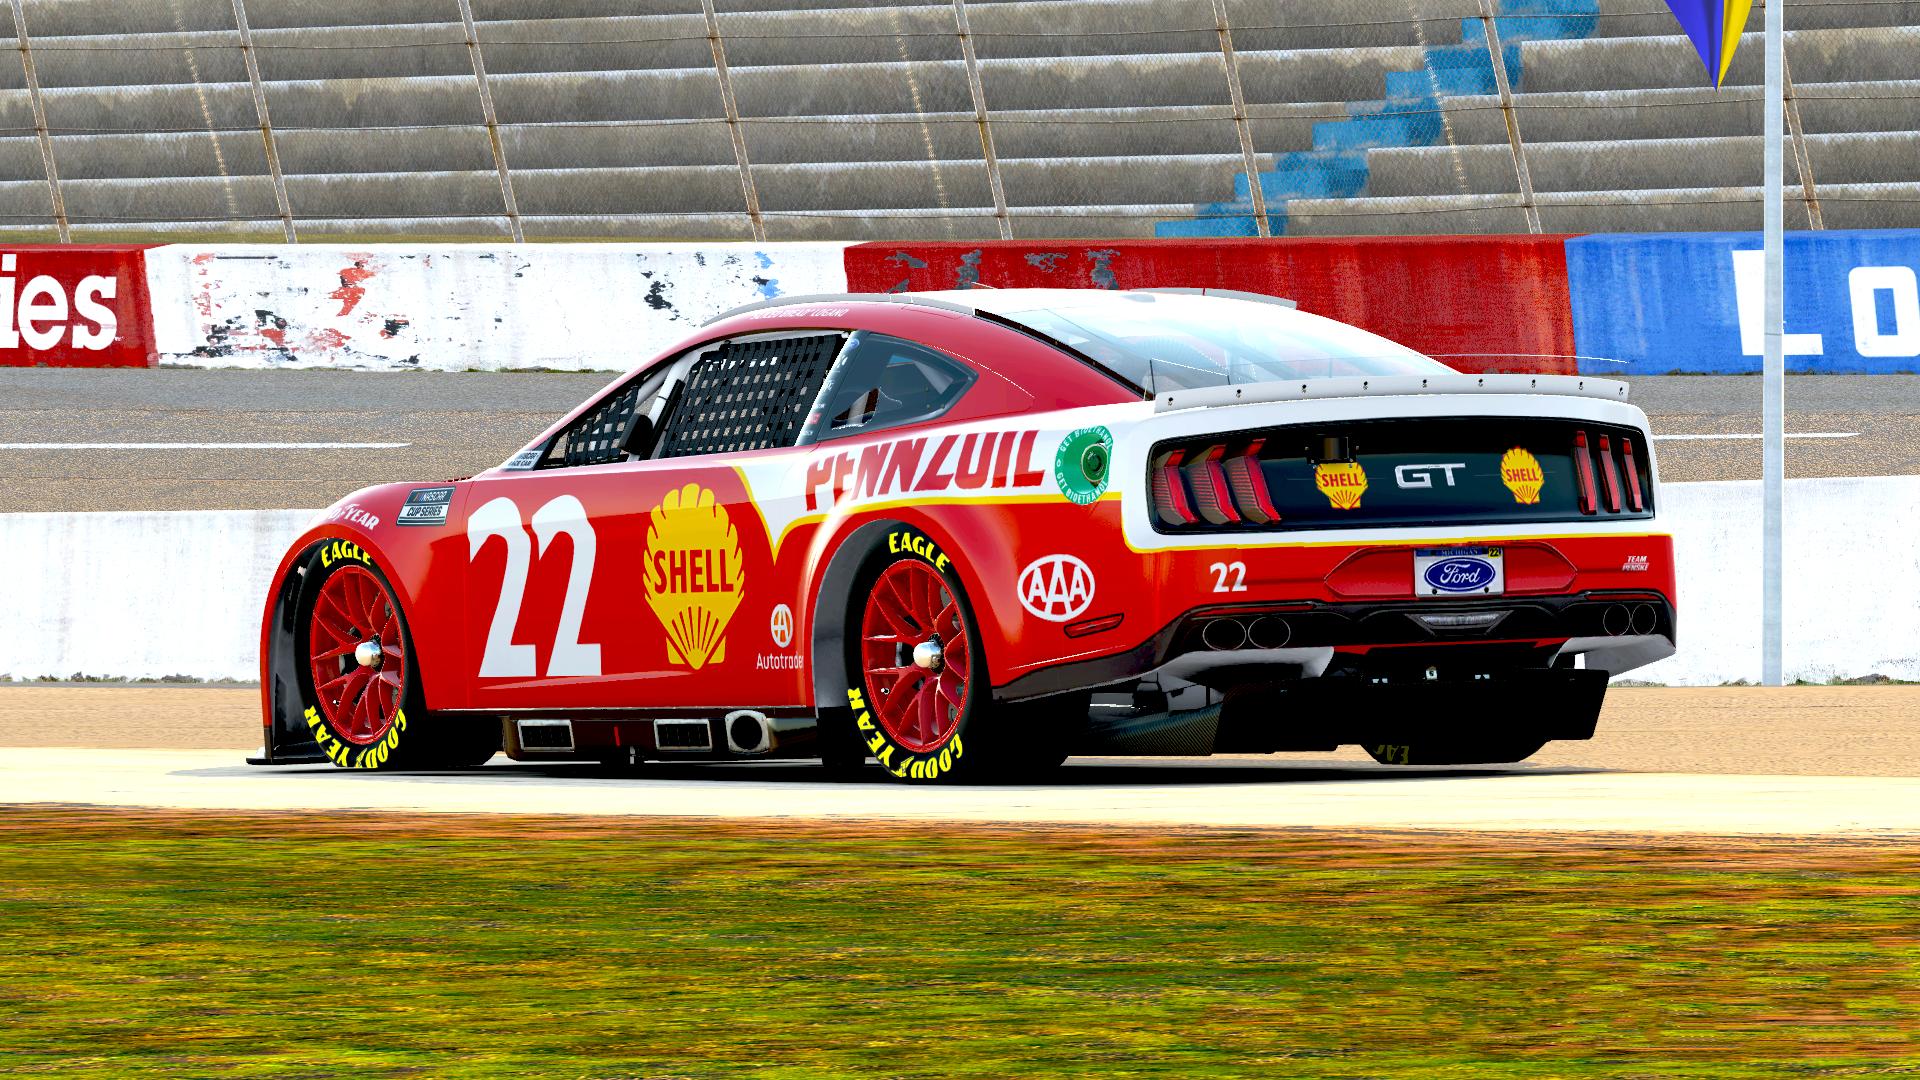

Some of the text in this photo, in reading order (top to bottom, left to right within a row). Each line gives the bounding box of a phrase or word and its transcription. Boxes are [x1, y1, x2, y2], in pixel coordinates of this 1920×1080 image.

[1059, 436, 1073, 452] GET
[1320, 470, 1364, 490] SHELL
[1395, 462, 1466, 490] GT
[1505, 467, 1541, 484] SHELL
[423, 490, 449, 502] NASCAR
[1057, 472, 1108, 504] GET BIOETHANOL
[407, 506, 443, 517] CUP SERIES
[321, 539, 372, 568] EAGLE
[888, 532, 950, 575] EAGLE
[1488, 548, 1500, 557] 22
[1627, 555, 1648, 563] TEAM
[653, 549, 734, 595] SHELL
[1209, 561, 1248, 593] 22
[1439, 563, 1481, 584] Ford
[1622, 563, 1649, 572] PENSKE
[467, 494, 602, 678] 22
[1029, 561, 1088, 622] AAA
